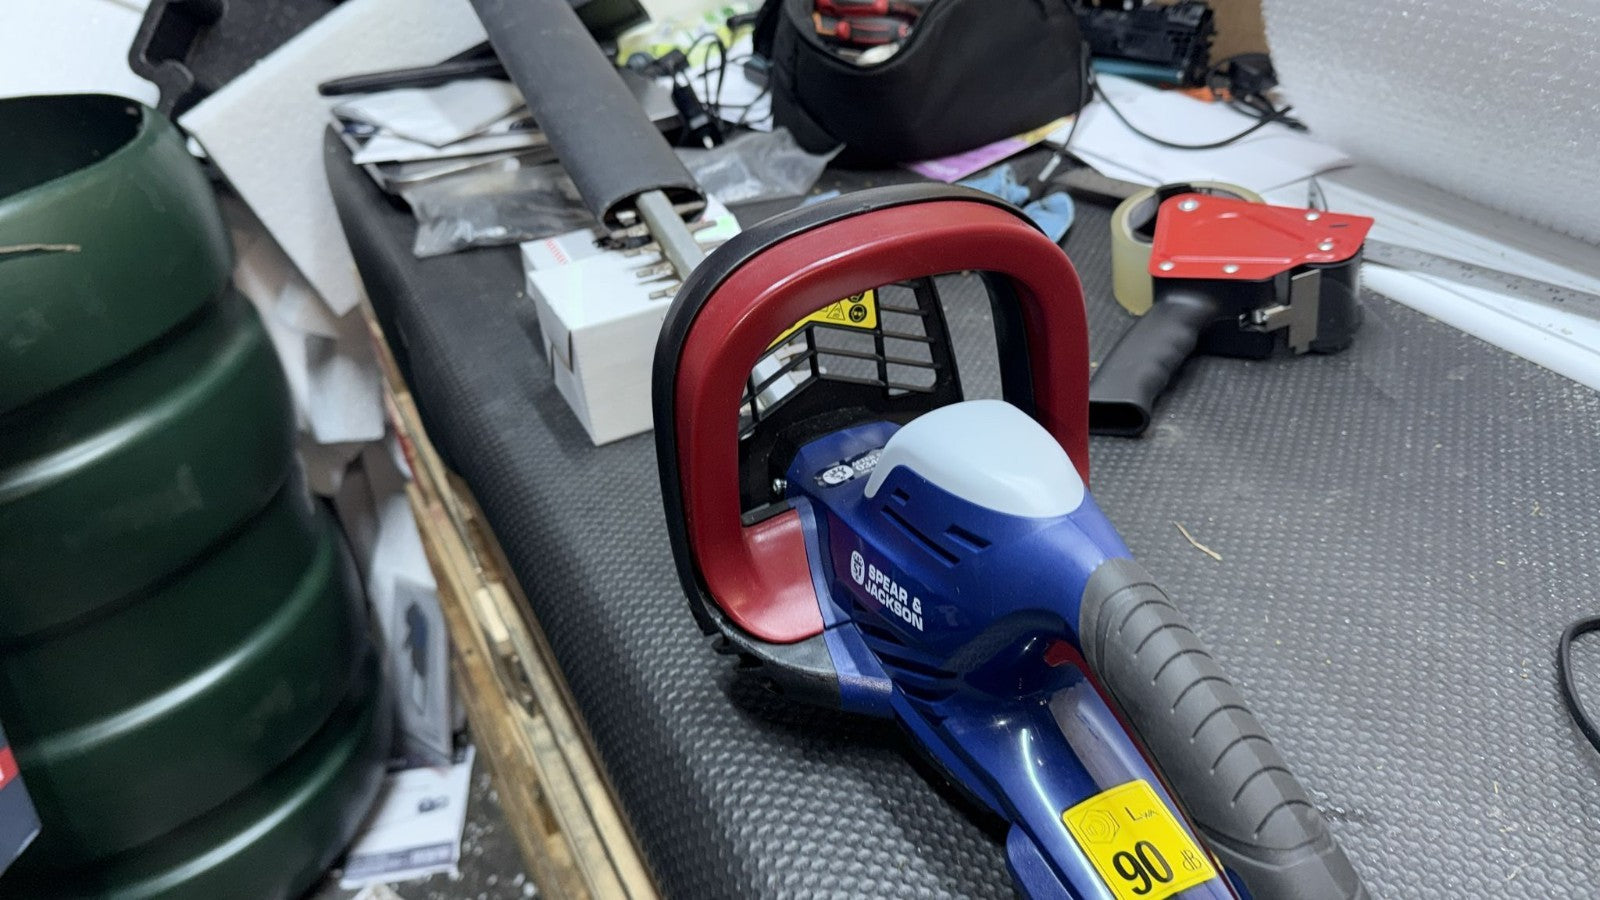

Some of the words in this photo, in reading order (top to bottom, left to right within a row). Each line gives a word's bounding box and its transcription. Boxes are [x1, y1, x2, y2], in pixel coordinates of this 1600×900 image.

[865, 579, 924, 631] JACKSON
[868, 563, 908, 606] SPEAR
[912, 596, 922, 615] &
[1112, 840, 1174, 895] 90
[1181, 849, 1202, 871] dB
